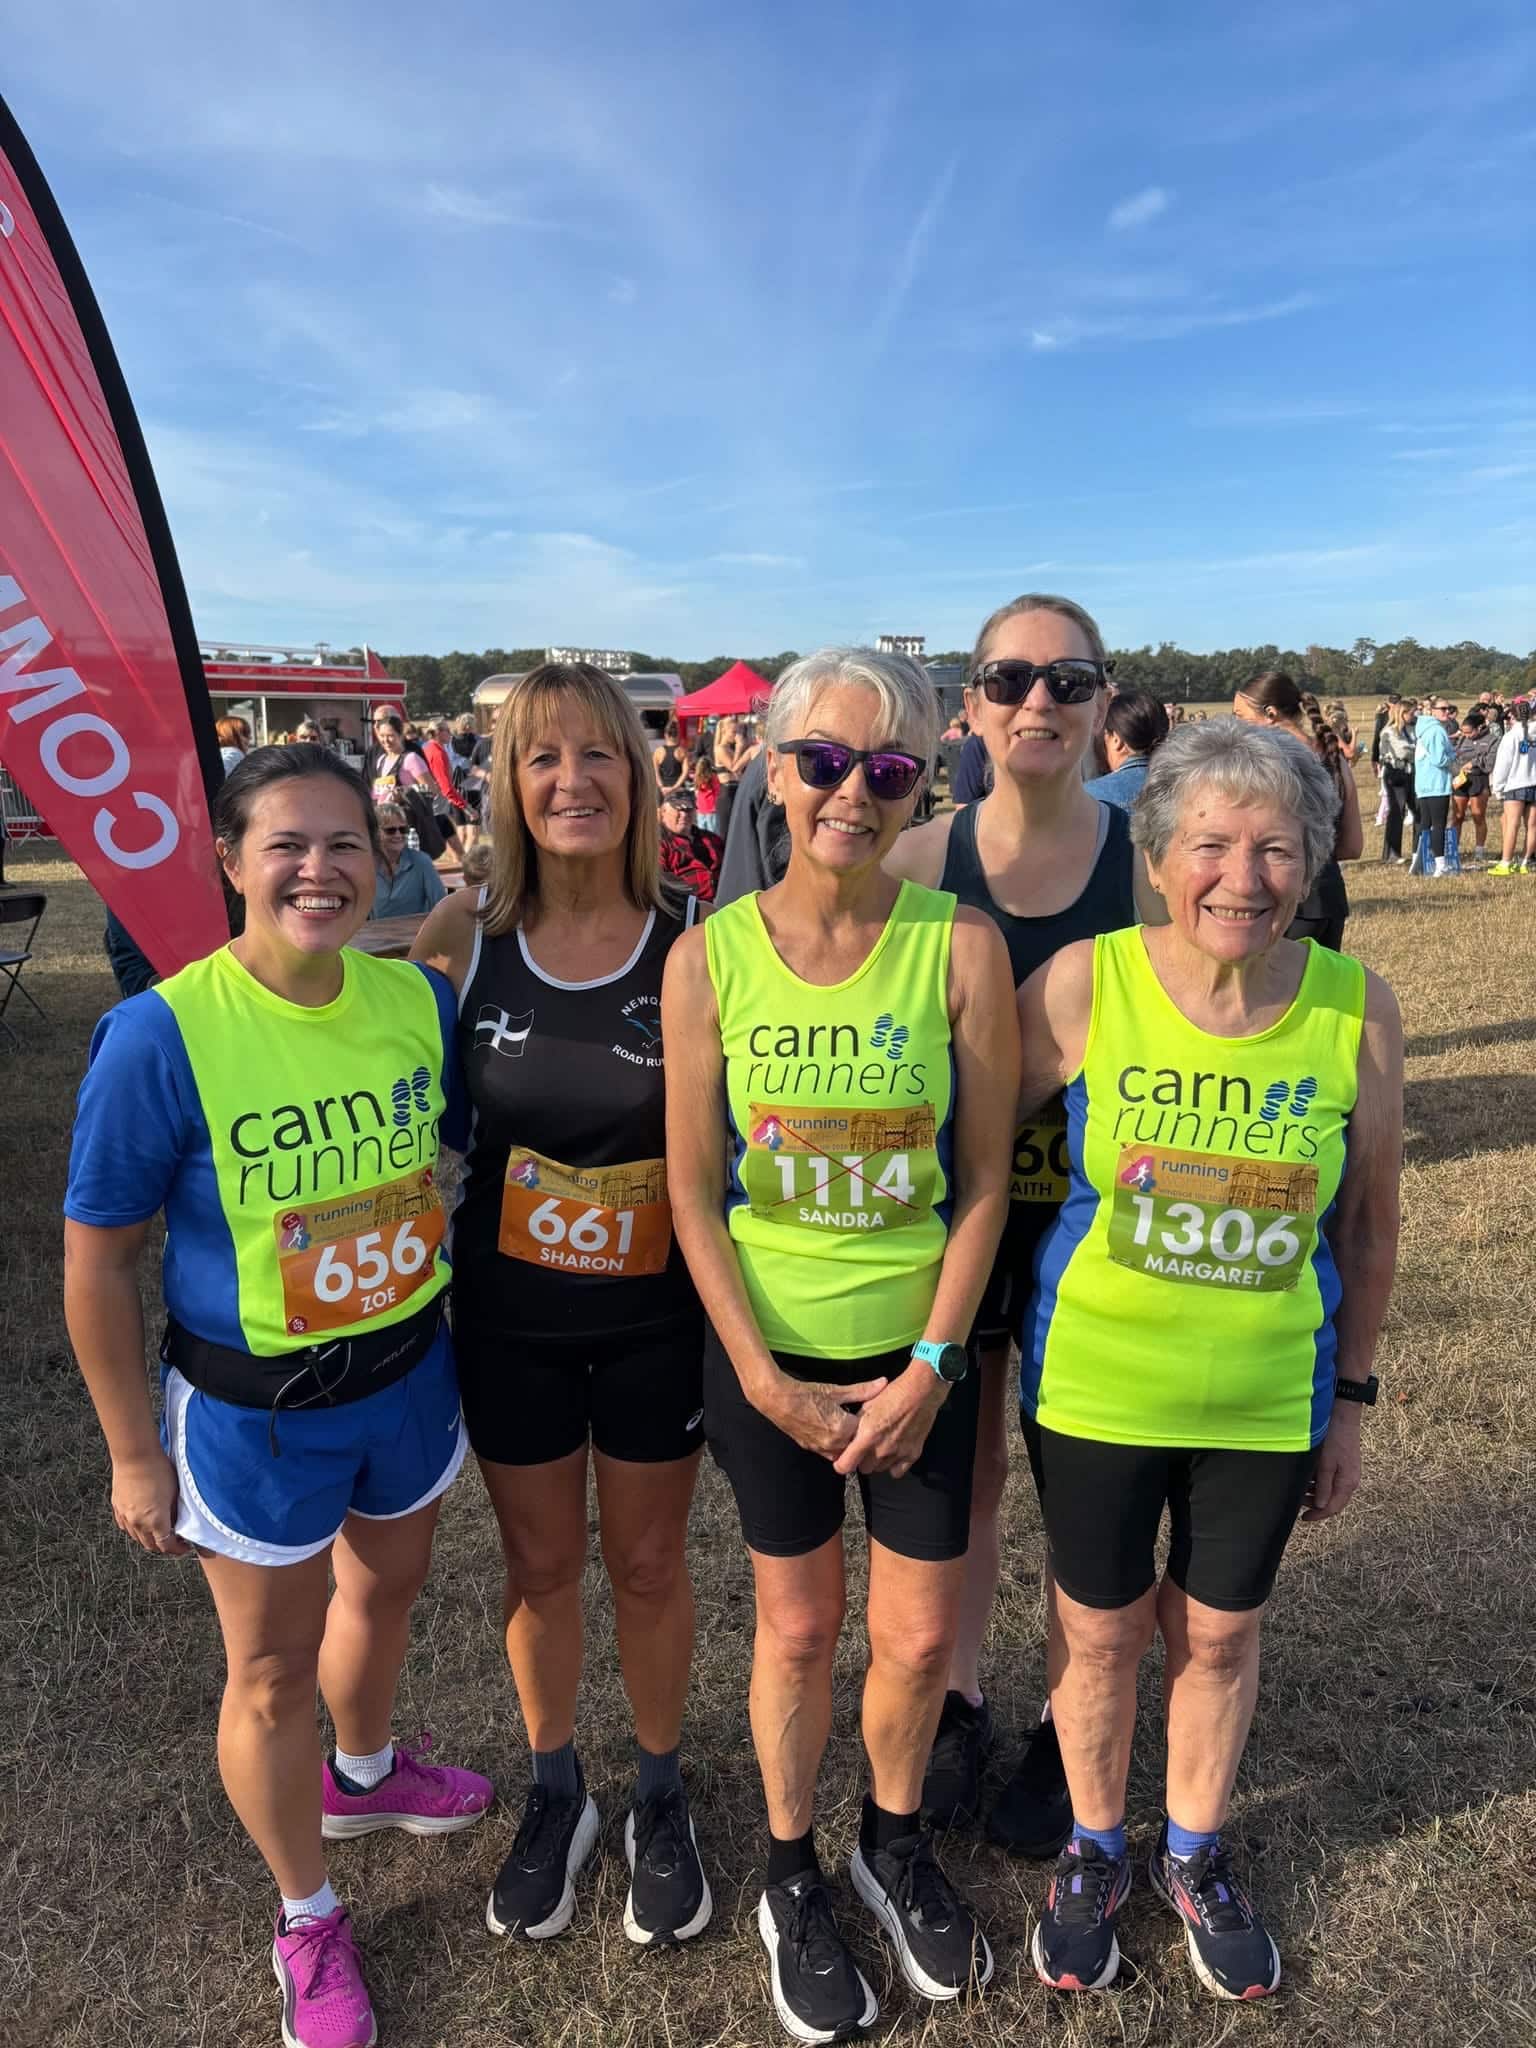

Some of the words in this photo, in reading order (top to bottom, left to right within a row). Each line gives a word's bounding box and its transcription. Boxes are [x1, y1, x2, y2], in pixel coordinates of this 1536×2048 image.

[0, 574, 179, 870] COM
[621, 995, 662, 1016] NEWQ
[612, 1045, 644, 1065] ROAD
[646, 1057, 665, 1068] RU
[750, 1023, 860, 1058] carn
[746, 1062, 927, 1095] runners
[1118, 1065, 1251, 1115] carn
[230, 1090, 386, 1158] carn
[786, 1115, 848, 1131] running
[1112, 1106, 1320, 1159] runners
[239, 1117, 440, 1205] runners
[1160, 1160, 1230, 1182] running
[774, 1153, 916, 1208] 1114
[1008, 1181, 1053, 1196] AITH
[313, 1199, 374, 1224] running
[527, 1197, 635, 1255] 661
[798, 1207, 886, 1229] SANDRA
[1131, 1195, 1300, 1267] 1306
[314, 1221, 428, 1303] 656
[539, 1247, 625, 1272] SHARON
[1144, 1253, 1265, 1287] MARGARET
[360, 1287, 397, 1314] ZOE
